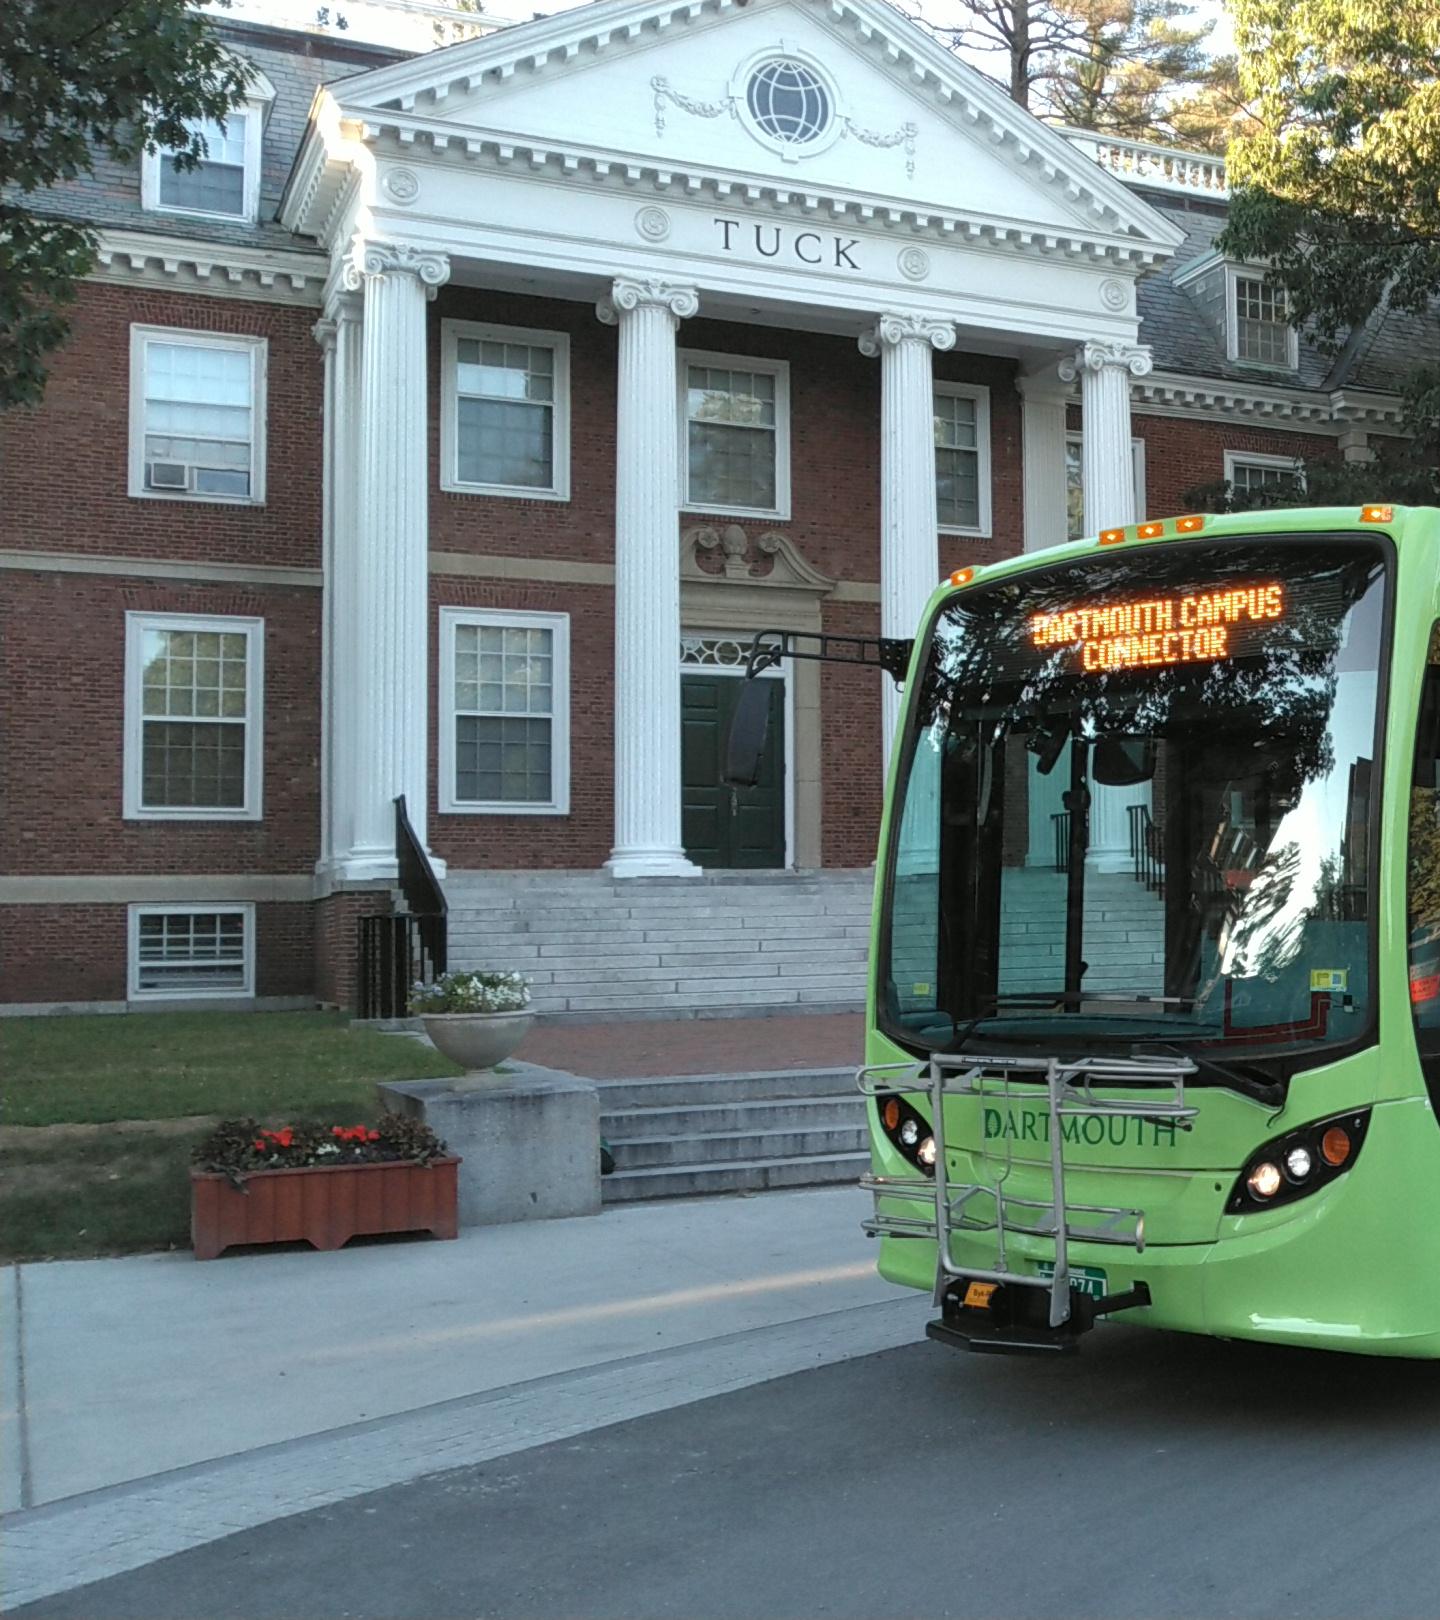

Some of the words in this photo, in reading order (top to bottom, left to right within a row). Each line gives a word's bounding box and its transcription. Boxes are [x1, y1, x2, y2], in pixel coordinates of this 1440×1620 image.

[714, 218, 861, 270] TUCK
[1033, 599, 1173, 645] DARTMOUTH
[1179, 586, 1282, 627] CAMPUS
[1083, 627, 1227, 670] CONNECTOR
[984, 1108, 1176, 1147] DARTMOUTH
